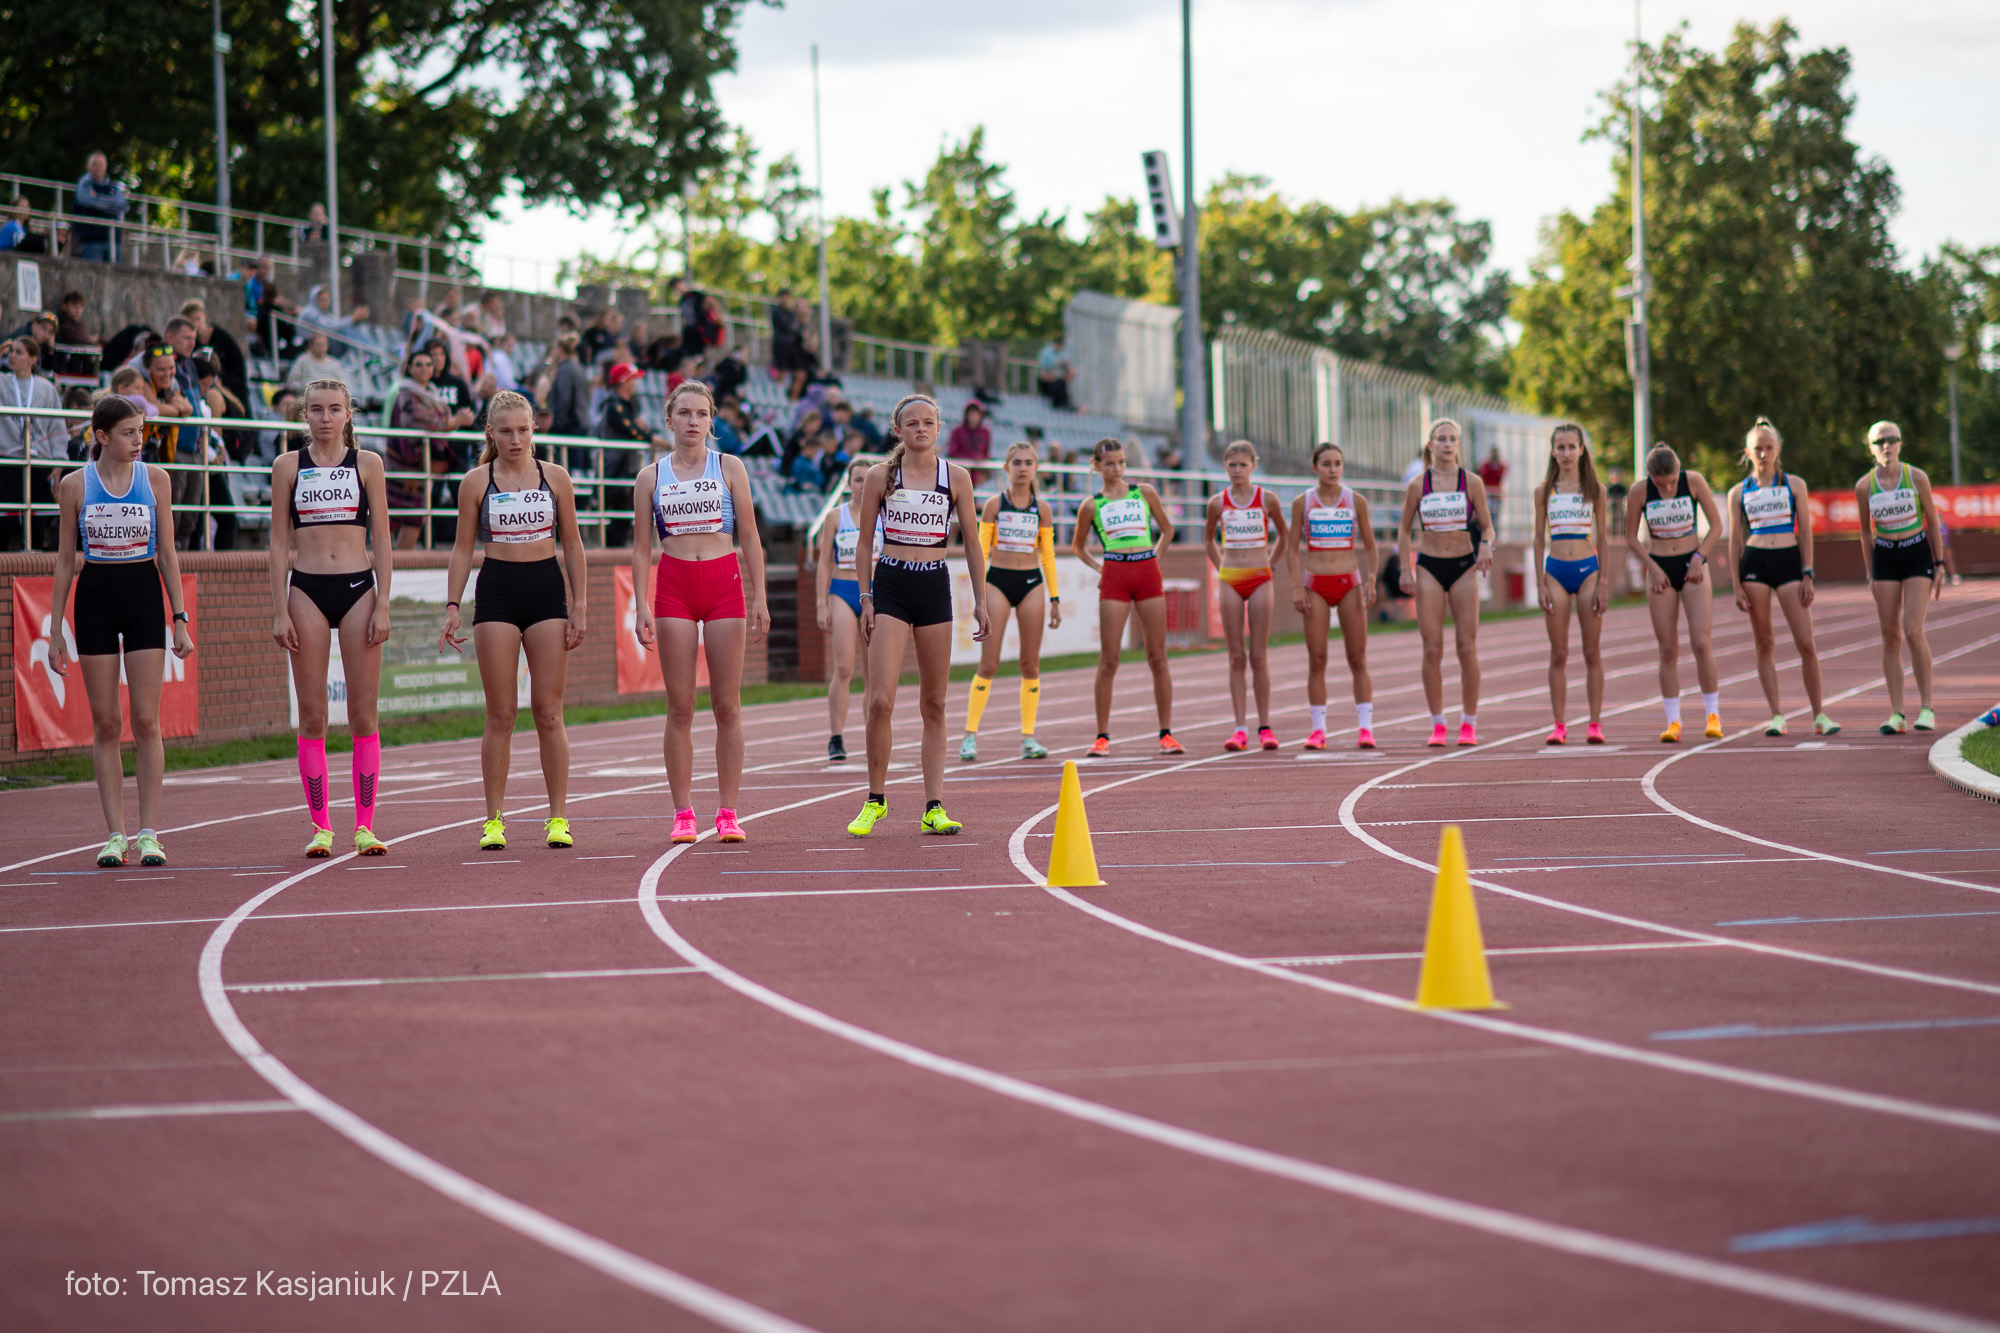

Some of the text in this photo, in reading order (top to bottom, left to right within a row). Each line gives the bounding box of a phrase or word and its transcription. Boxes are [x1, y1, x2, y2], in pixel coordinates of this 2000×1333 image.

[330, 469, 351, 481] 697
[694, 481, 717, 493] 934
[302, 488, 353, 503] SIKORA
[523, 492, 547, 503] 692
[921, 493, 944, 506] 743
[1445, 494, 1461, 503] 587
[1894, 491, 1911, 501] 243
[661, 500, 722, 517] MAKOWSKA
[1125, 501, 1141, 509] 391
[1671, 500, 1688, 509] 614
[121, 506, 144, 517] 941
[1246, 510, 1262, 520] 125
[1334, 510, 1350, 518] 428
[1550, 507, 1591, 520] DUDZIŃSKA
[1874, 504, 1914, 518] GÓRSKA
[499, 510, 545, 526] RAKUS
[888, 510, 944, 526] PAPROTA
[1022, 515, 1037, 524] 373
[1106, 514, 1142, 526] SZLAGA
[88, 523, 148, 539] BŁAŻEJEWSKA
[903, 560, 938, 572] NIKE
